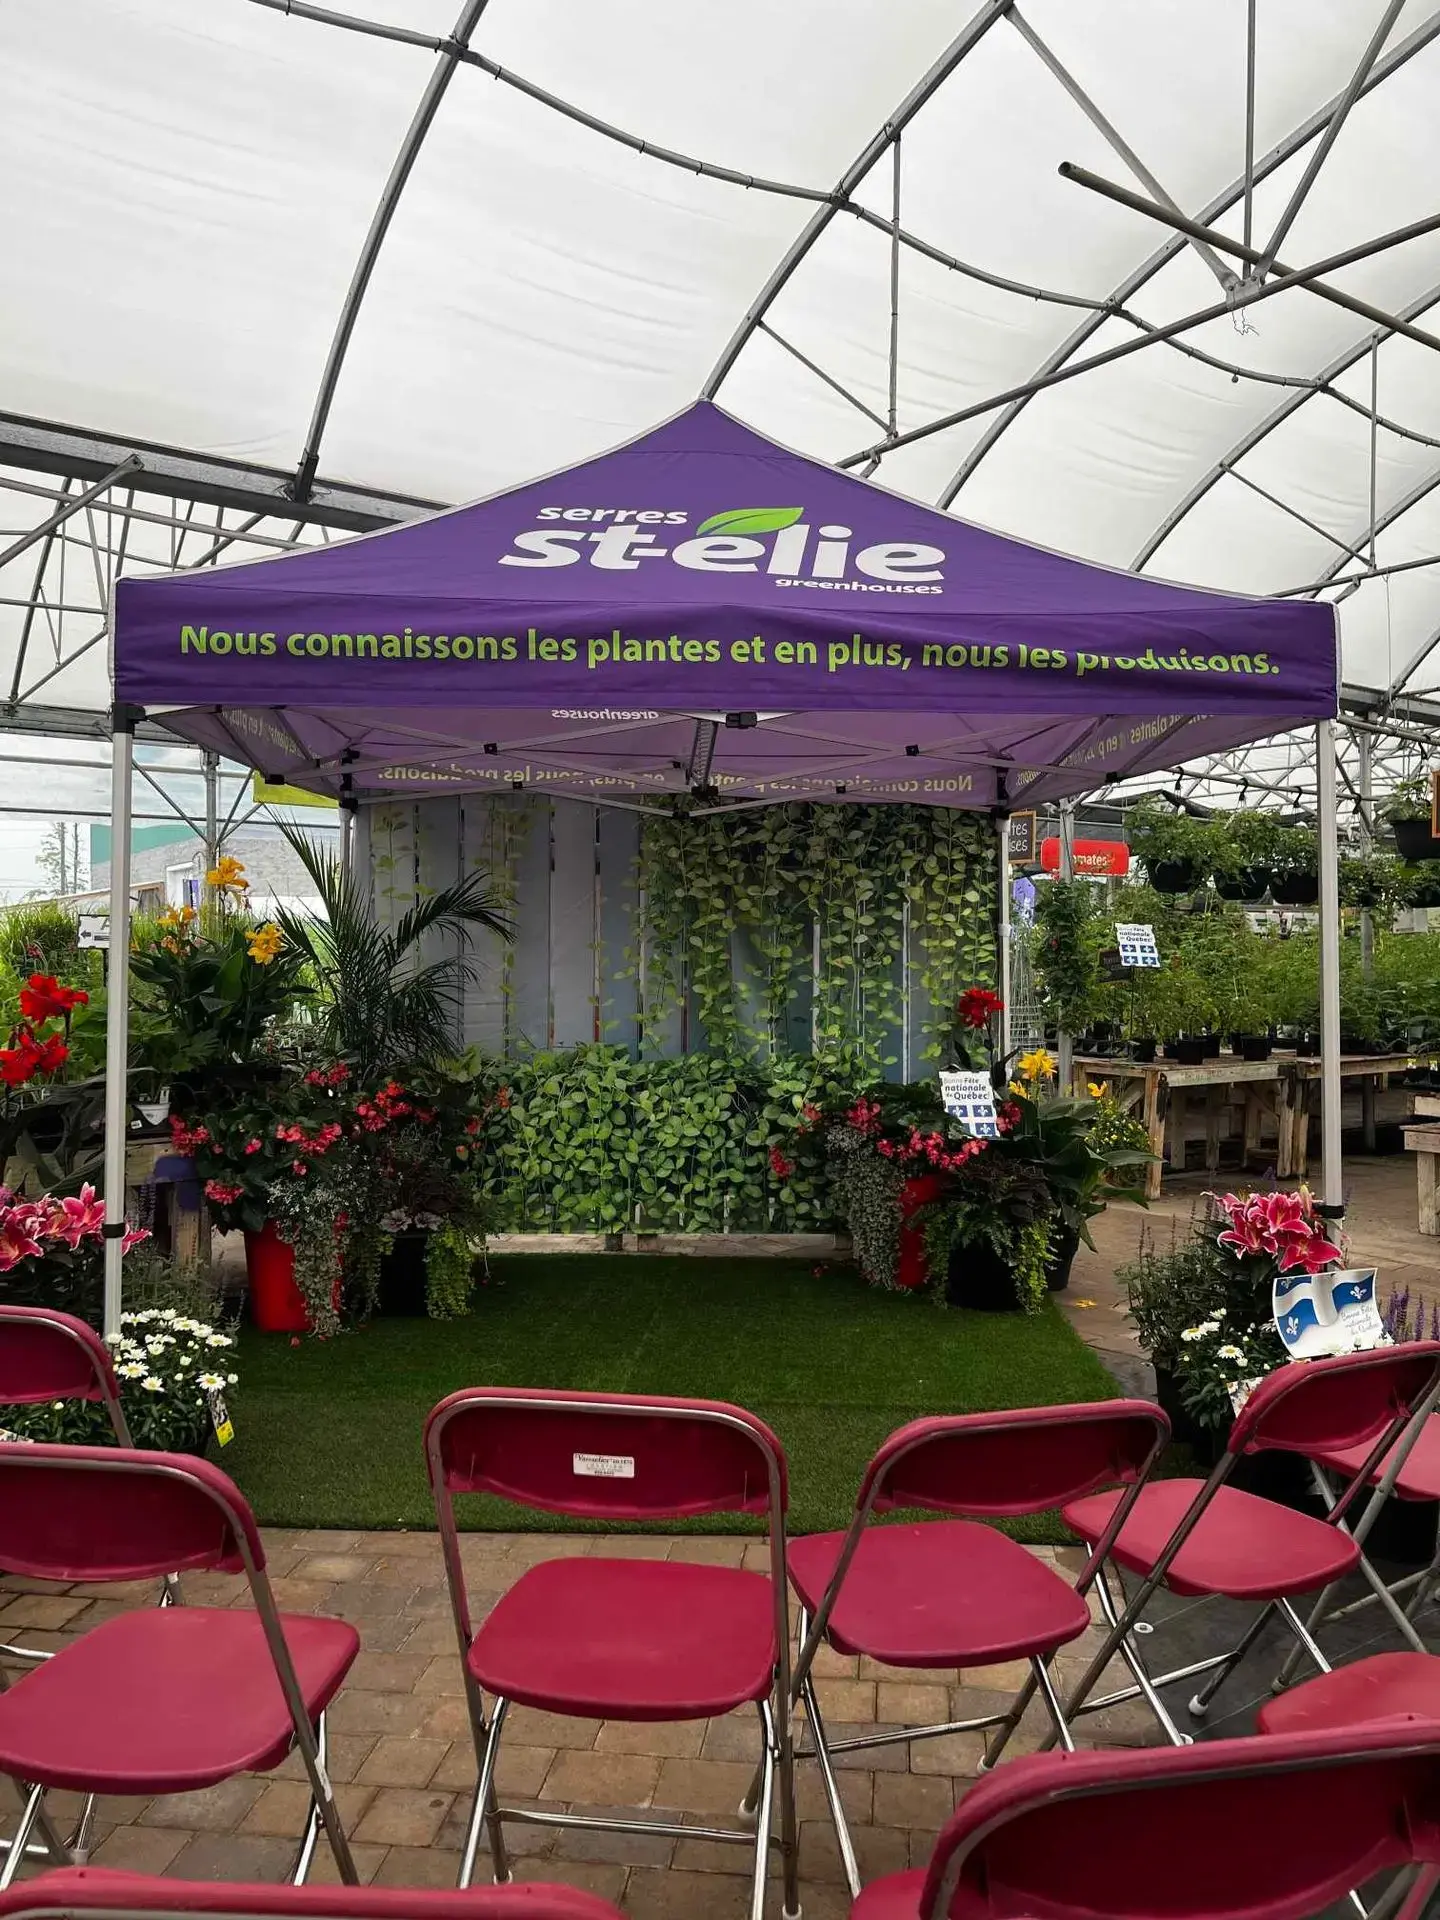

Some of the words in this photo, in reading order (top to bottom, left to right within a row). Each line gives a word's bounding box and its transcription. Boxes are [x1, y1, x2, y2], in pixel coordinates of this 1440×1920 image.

[536, 506, 688, 526] serres
[775, 576, 943, 595] greenhouses
[180, 625, 277, 656] Nous
[286, 627, 517, 661] connaissons
[527, 628, 578, 662] les
[587, 629, 721, 669] plantes
[729, 635, 766, 664] et
[774, 639, 817, 665] en
[828, 633, 912, 673] plus,
[922, 643, 1010, 668] nous
[1018, 643, 1067, 670] les
[1076, 648, 1281, 677] produisons.
[945, 1083, 987, 1092] nationale
